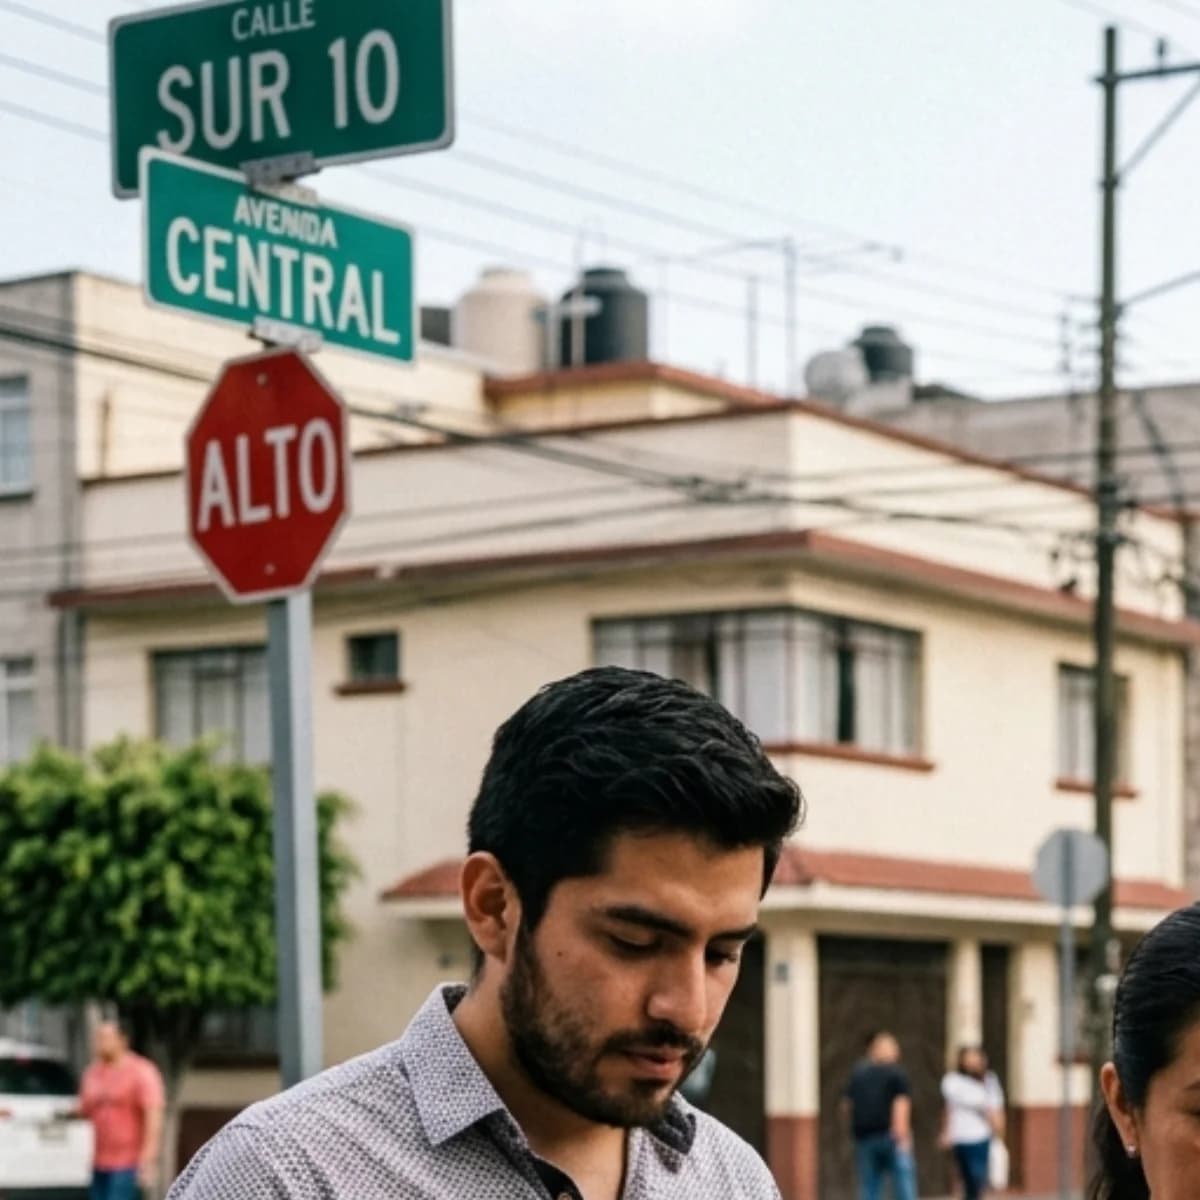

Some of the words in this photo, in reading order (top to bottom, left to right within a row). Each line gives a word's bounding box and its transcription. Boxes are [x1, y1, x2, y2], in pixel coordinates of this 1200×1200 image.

[231, 0, 316, 41] CALLE
[156, 49, 291, 153] SUR
[327, 29, 399, 129] 10
[166, 216, 400, 345] CENTRAL
[197, 417, 338, 532] ALTO
